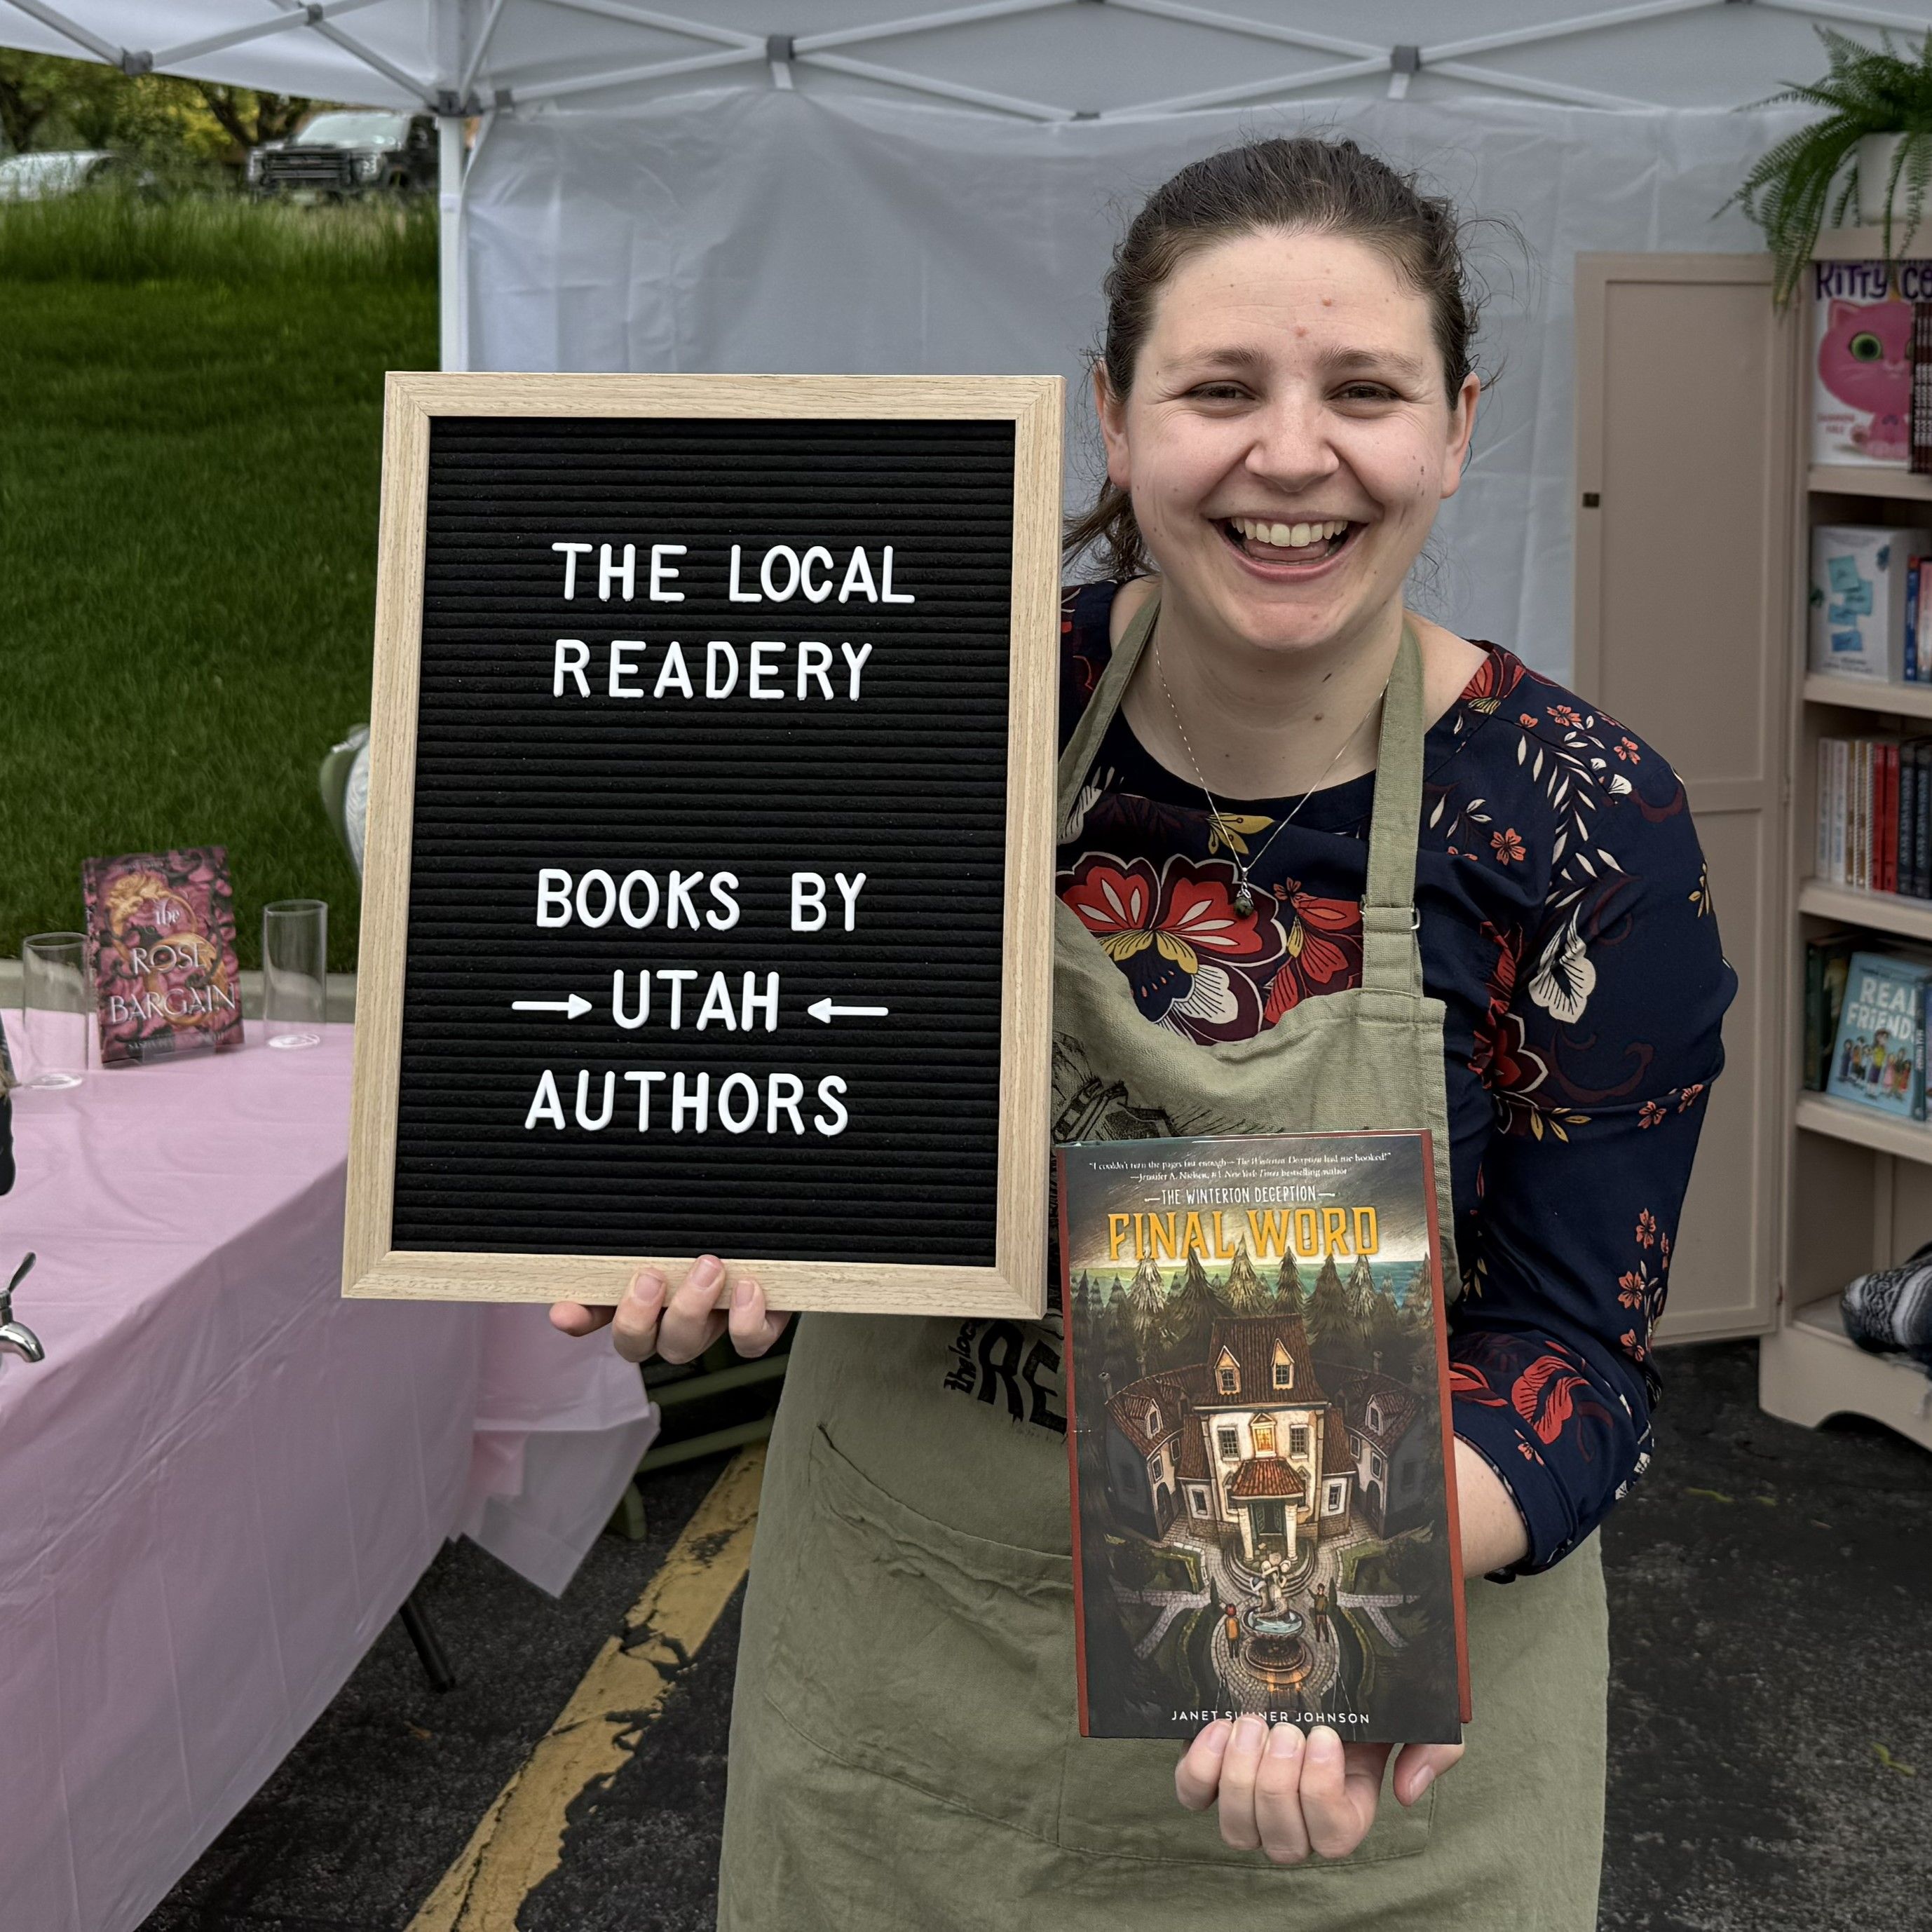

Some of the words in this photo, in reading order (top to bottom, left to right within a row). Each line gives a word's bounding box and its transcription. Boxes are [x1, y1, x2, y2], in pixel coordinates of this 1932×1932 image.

[552, 543, 687, 602] THE
[730, 545, 915, 603] LOCAL
[554, 639, 872, 701] READERY
[537, 869, 740, 930] BOOKS
[791, 873, 866, 931] BY
[109, 983, 235, 1024] BARGAIN
[613, 970, 779, 1032] UTAH
[1846, 1002, 1914, 1044] FRIEND
[525, 1070, 848, 1136] AUTHORS
[1162, 1189, 1181, 1205] THE
[1185, 1187, 1250, 1204] WINTERTON
[1255, 1185, 1317, 1203] DECEPTION
[1108, 1209, 1235, 1260] FINAL
[1245, 1206, 1379, 1258] WORD
[1171, 1710, 1217, 1721] JANET
[1225, 1710, 1288, 1722] SUNER
[1295, 1712, 1369, 1724] JOHNSON
